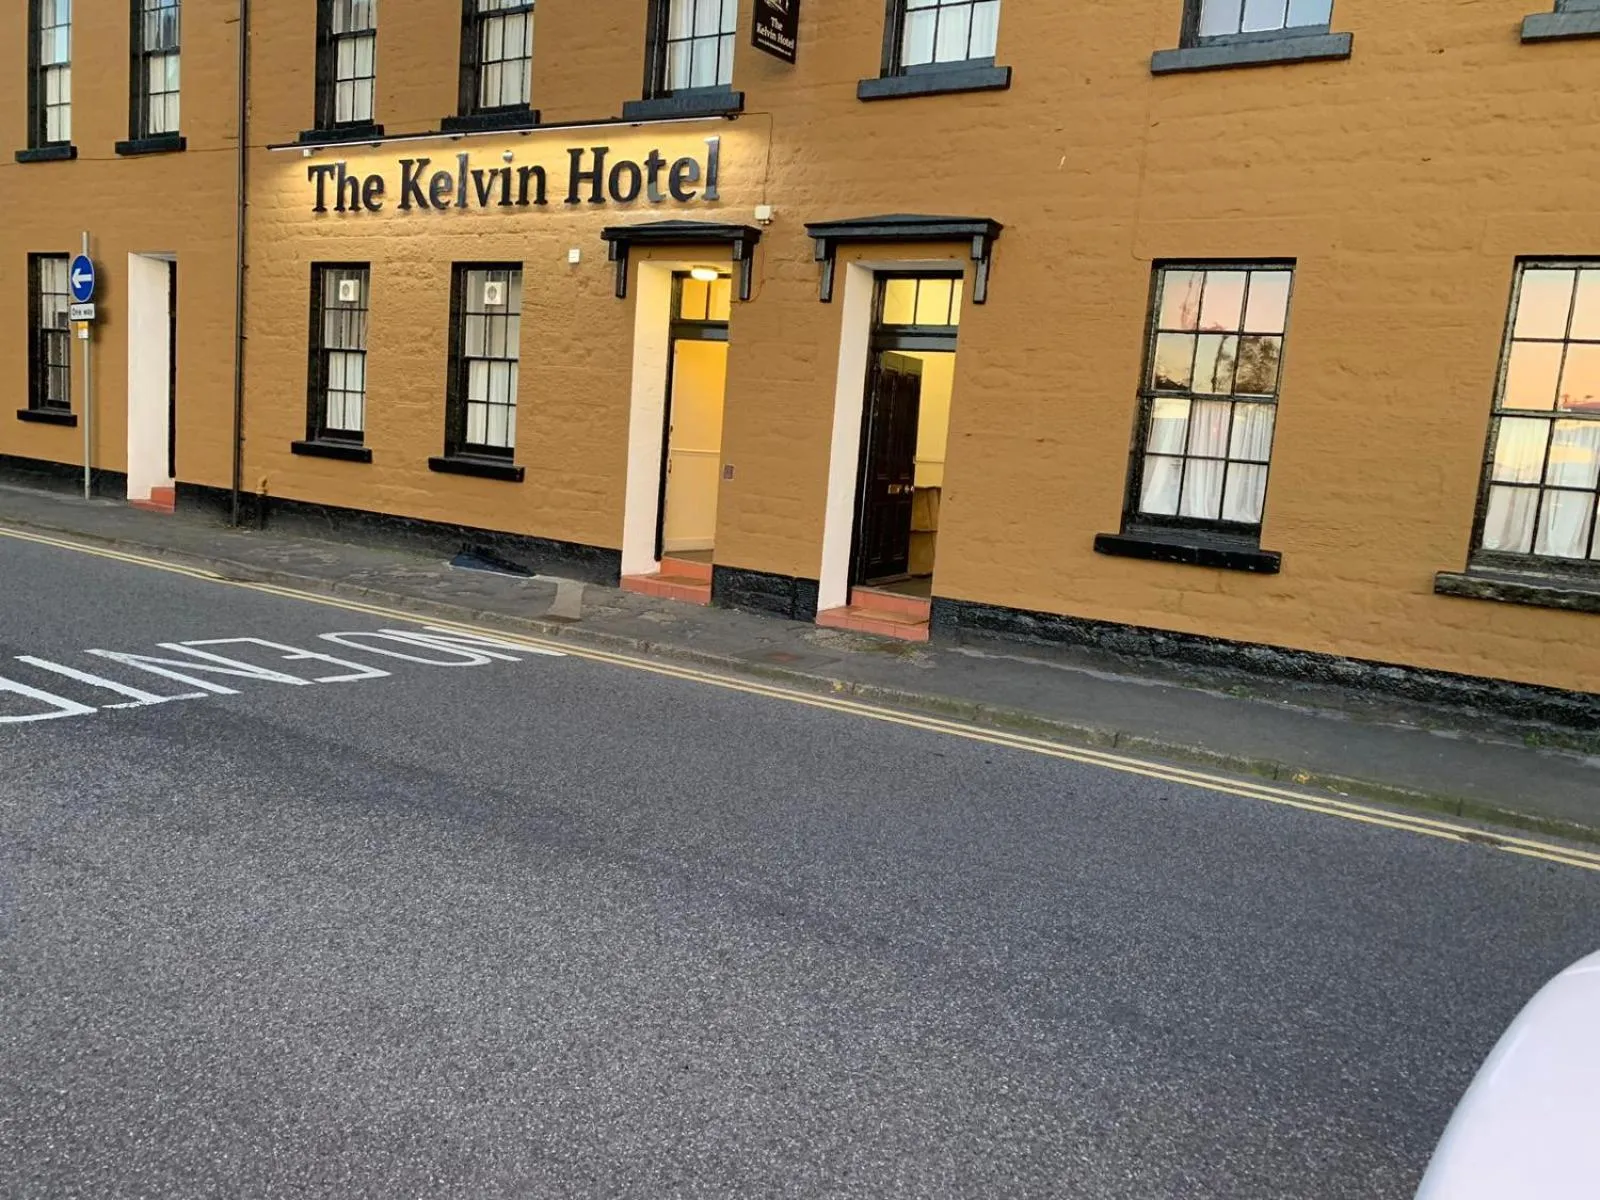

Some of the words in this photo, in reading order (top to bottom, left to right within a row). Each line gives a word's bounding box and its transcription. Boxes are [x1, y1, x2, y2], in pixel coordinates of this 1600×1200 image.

[756, 22, 777, 40] Kelvin
[777, 32, 795, 49] Hotel
[770, 16, 783, 31] The
[308, 161, 384, 212] The
[397, 149, 547, 210] Kelvin
[564, 135, 720, 205] Hotel
